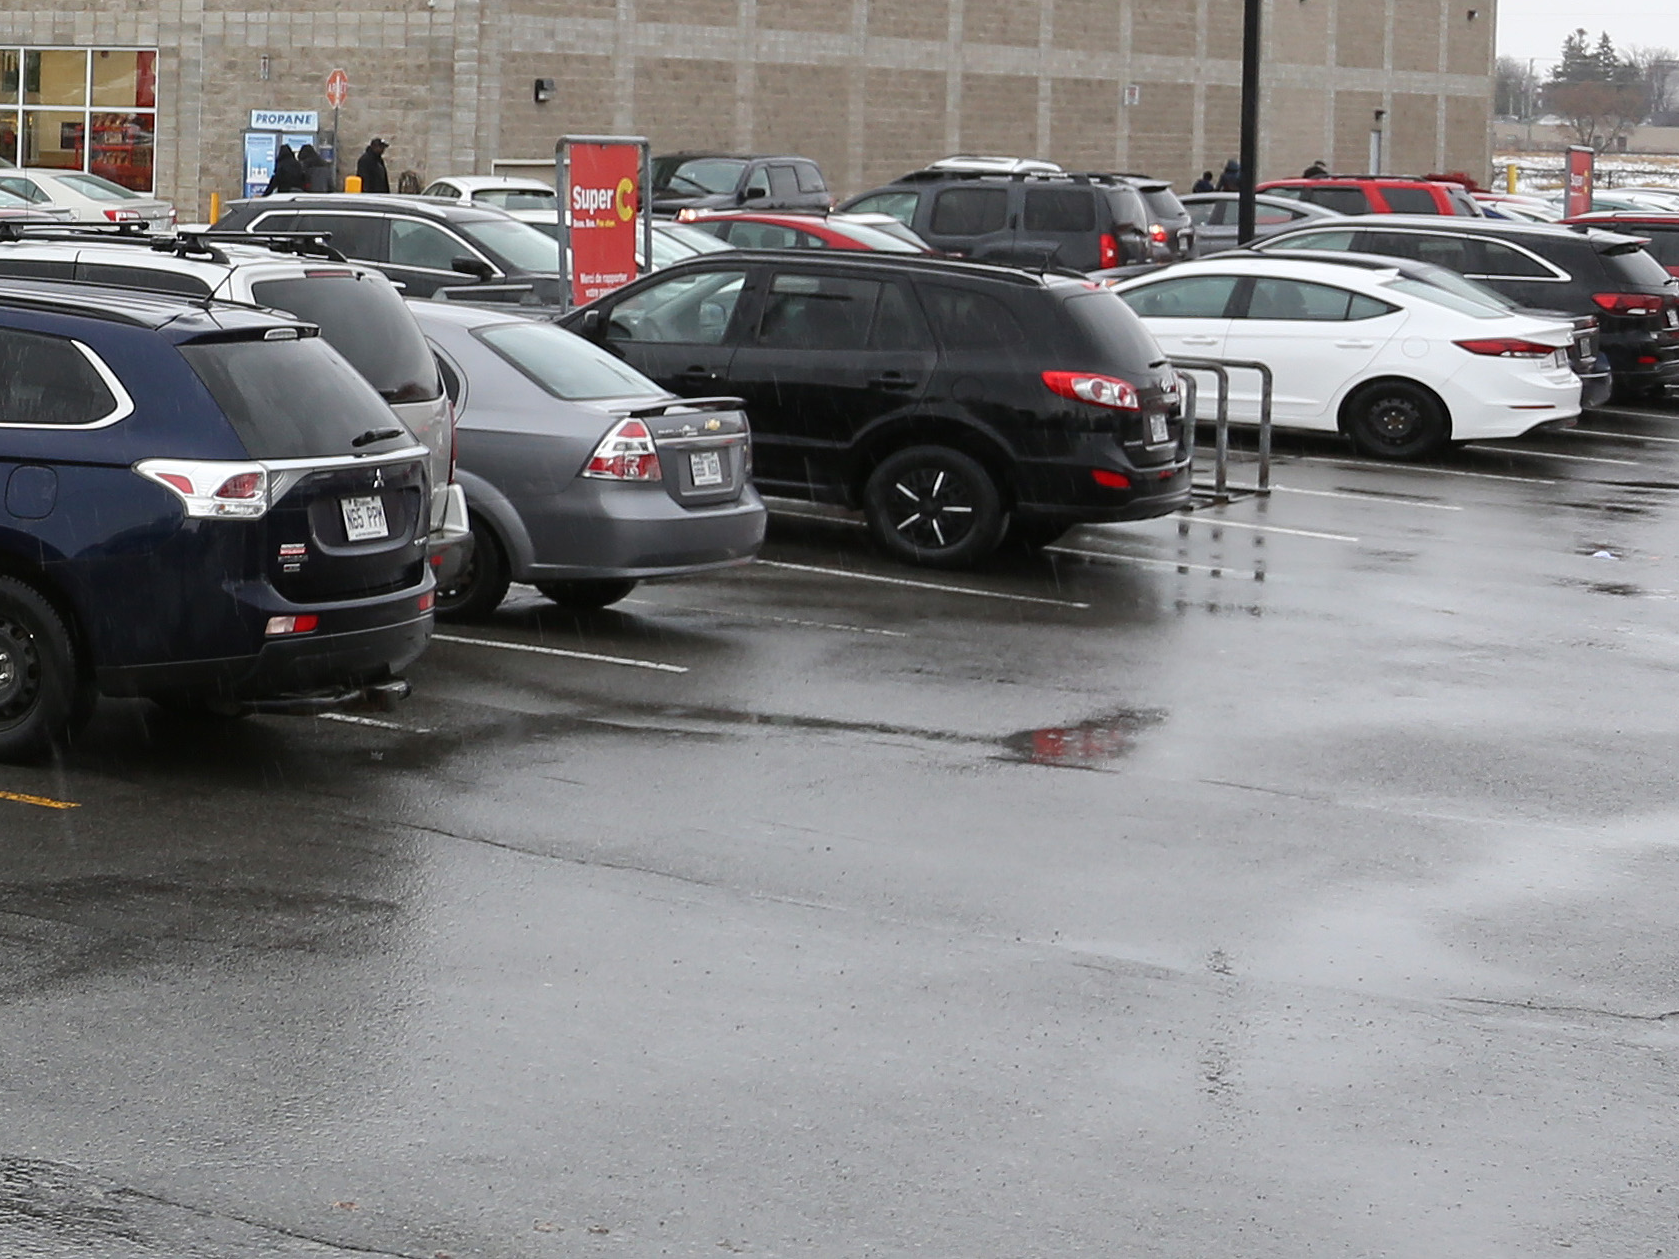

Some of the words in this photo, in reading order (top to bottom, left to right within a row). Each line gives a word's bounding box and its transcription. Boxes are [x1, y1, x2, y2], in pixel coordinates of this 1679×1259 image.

[255, 113, 312, 125] PROPANE
[572, 184, 614, 216] Super
[616, 177, 634, 222] C
